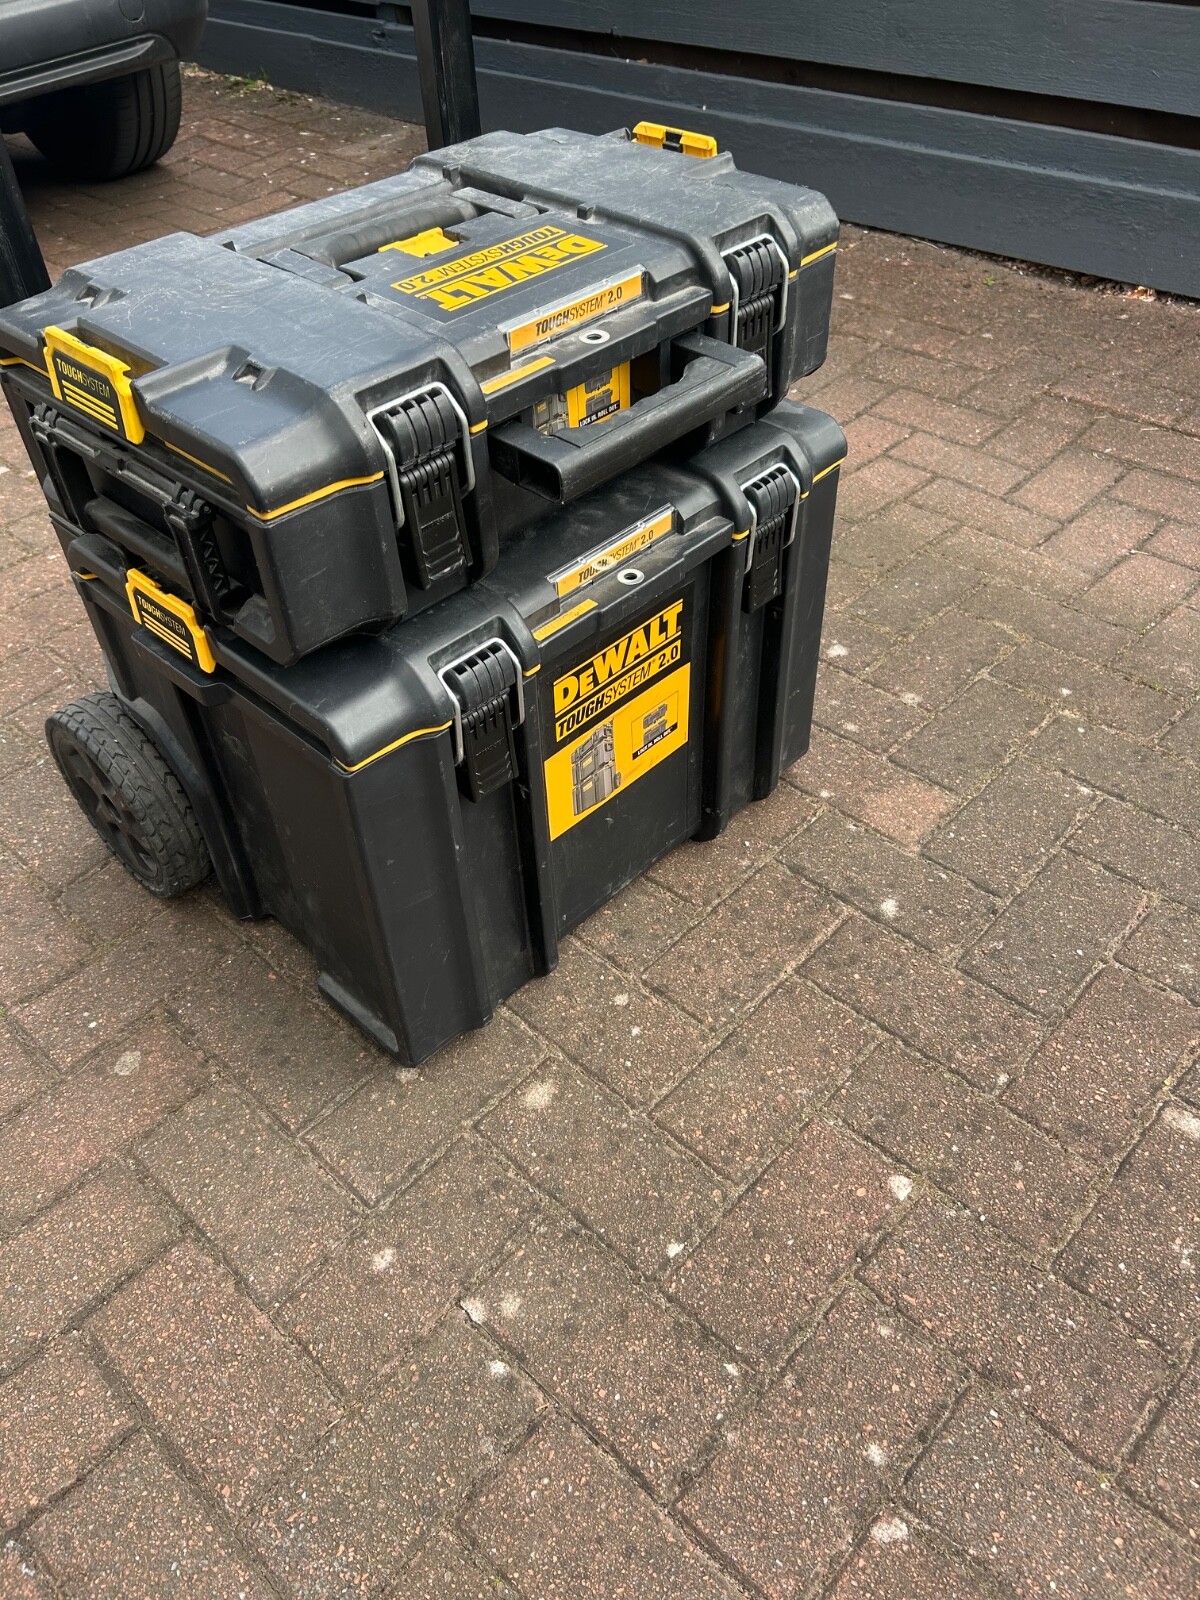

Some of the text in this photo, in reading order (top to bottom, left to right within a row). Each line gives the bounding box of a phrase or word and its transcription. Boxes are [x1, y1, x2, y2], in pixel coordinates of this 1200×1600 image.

[399, 227, 561, 290] TOUGHSYSTEM 2.0
[535, 286, 622, 337] TOUGHSYSTEM 2.0
[56, 357, 111, 399] TOUGHSYSTEM
[578, 529, 654, 583] TOUHYSTEM 2.0
[136, 594, 186, 637] TOUGHSYSTEM
[558, 644, 678, 739] TOUGHSYSTEM 2.0
